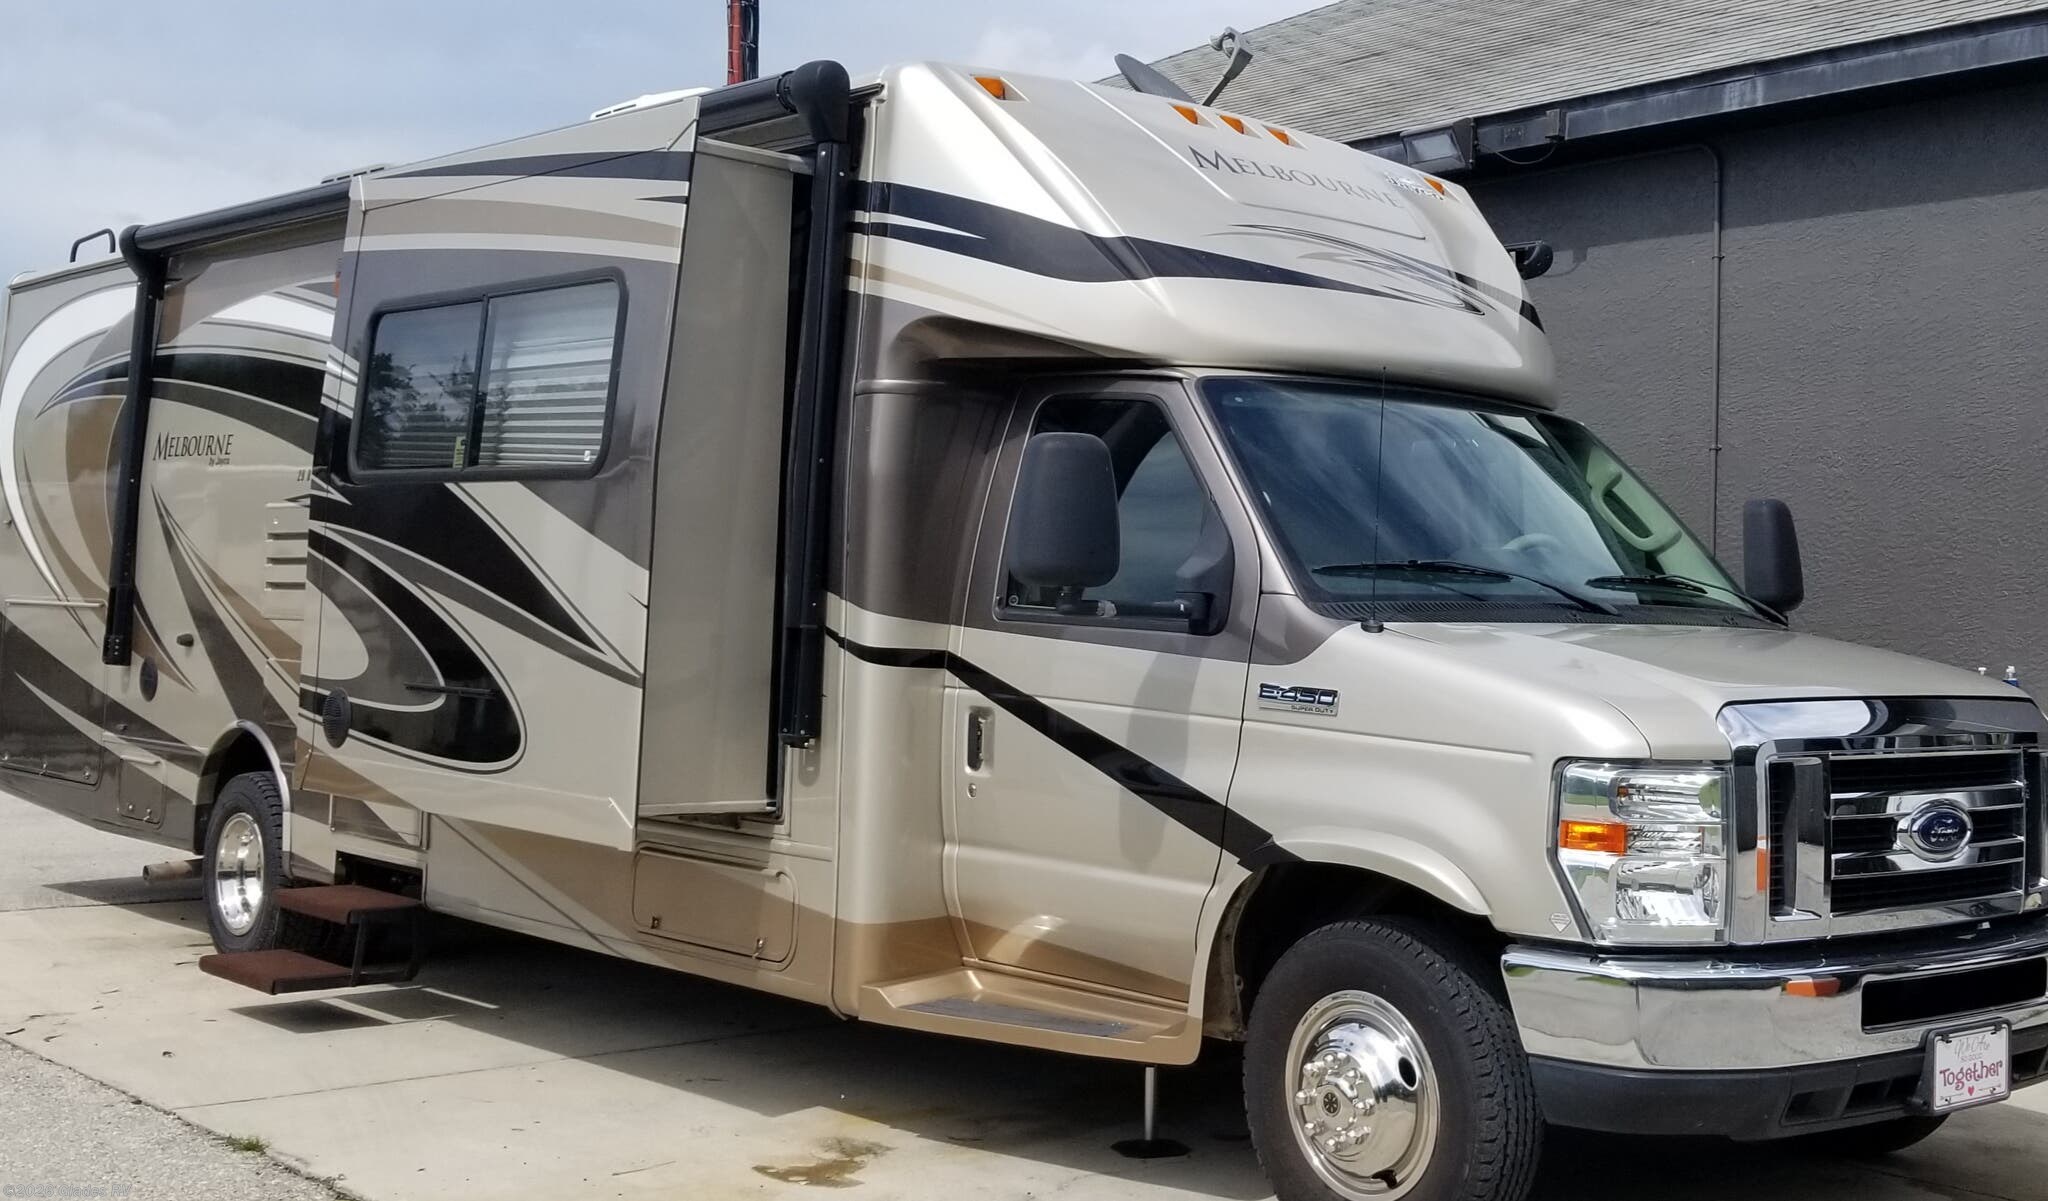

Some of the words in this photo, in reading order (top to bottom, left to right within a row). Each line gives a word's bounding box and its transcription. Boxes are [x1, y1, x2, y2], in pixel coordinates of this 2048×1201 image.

[1187, 145, 1404, 208] MELBOURNE
[152, 432, 235, 461] MELBOURNE
[1291, 704, 1313, 712] SUPER
[1939, 1060, 2003, 1091] Together
